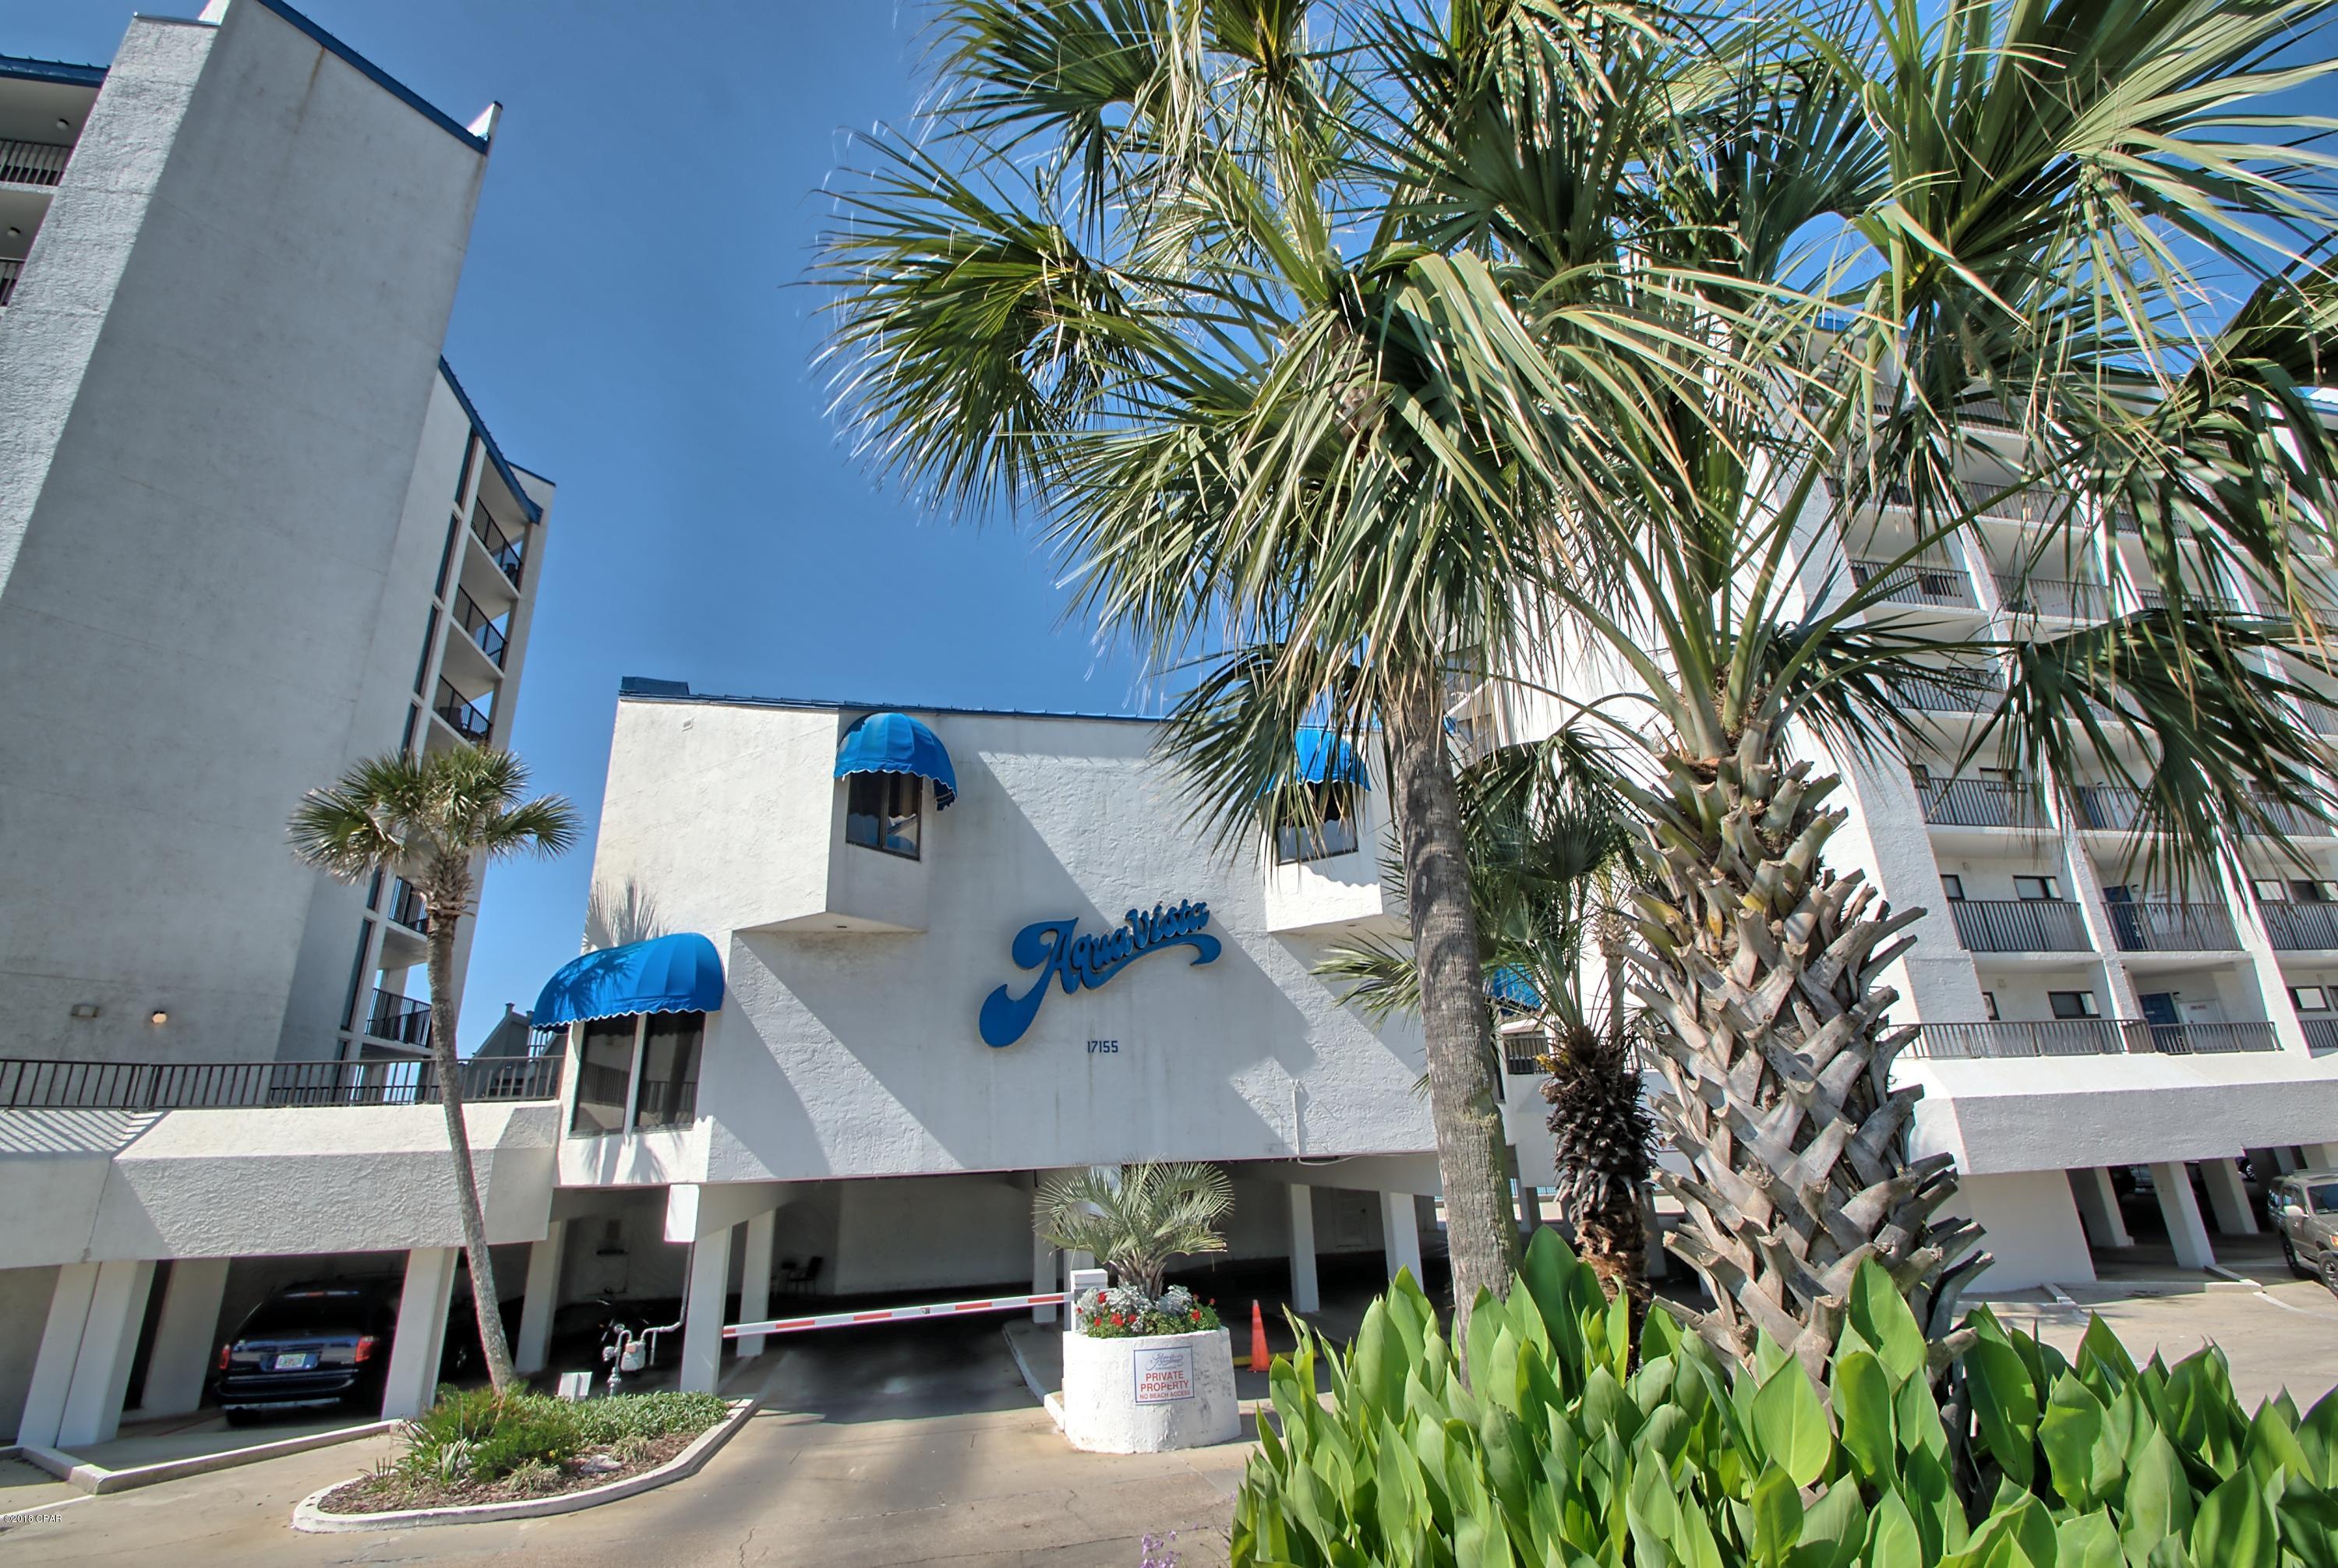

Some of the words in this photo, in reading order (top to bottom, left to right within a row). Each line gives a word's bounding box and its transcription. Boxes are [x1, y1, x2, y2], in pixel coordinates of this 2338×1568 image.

[1087, 1040, 1118, 1054] 17155
[1146, 1371, 1184, 1381] PRIVATE
[1140, 1380, 1188, 1392] PROPERTY
